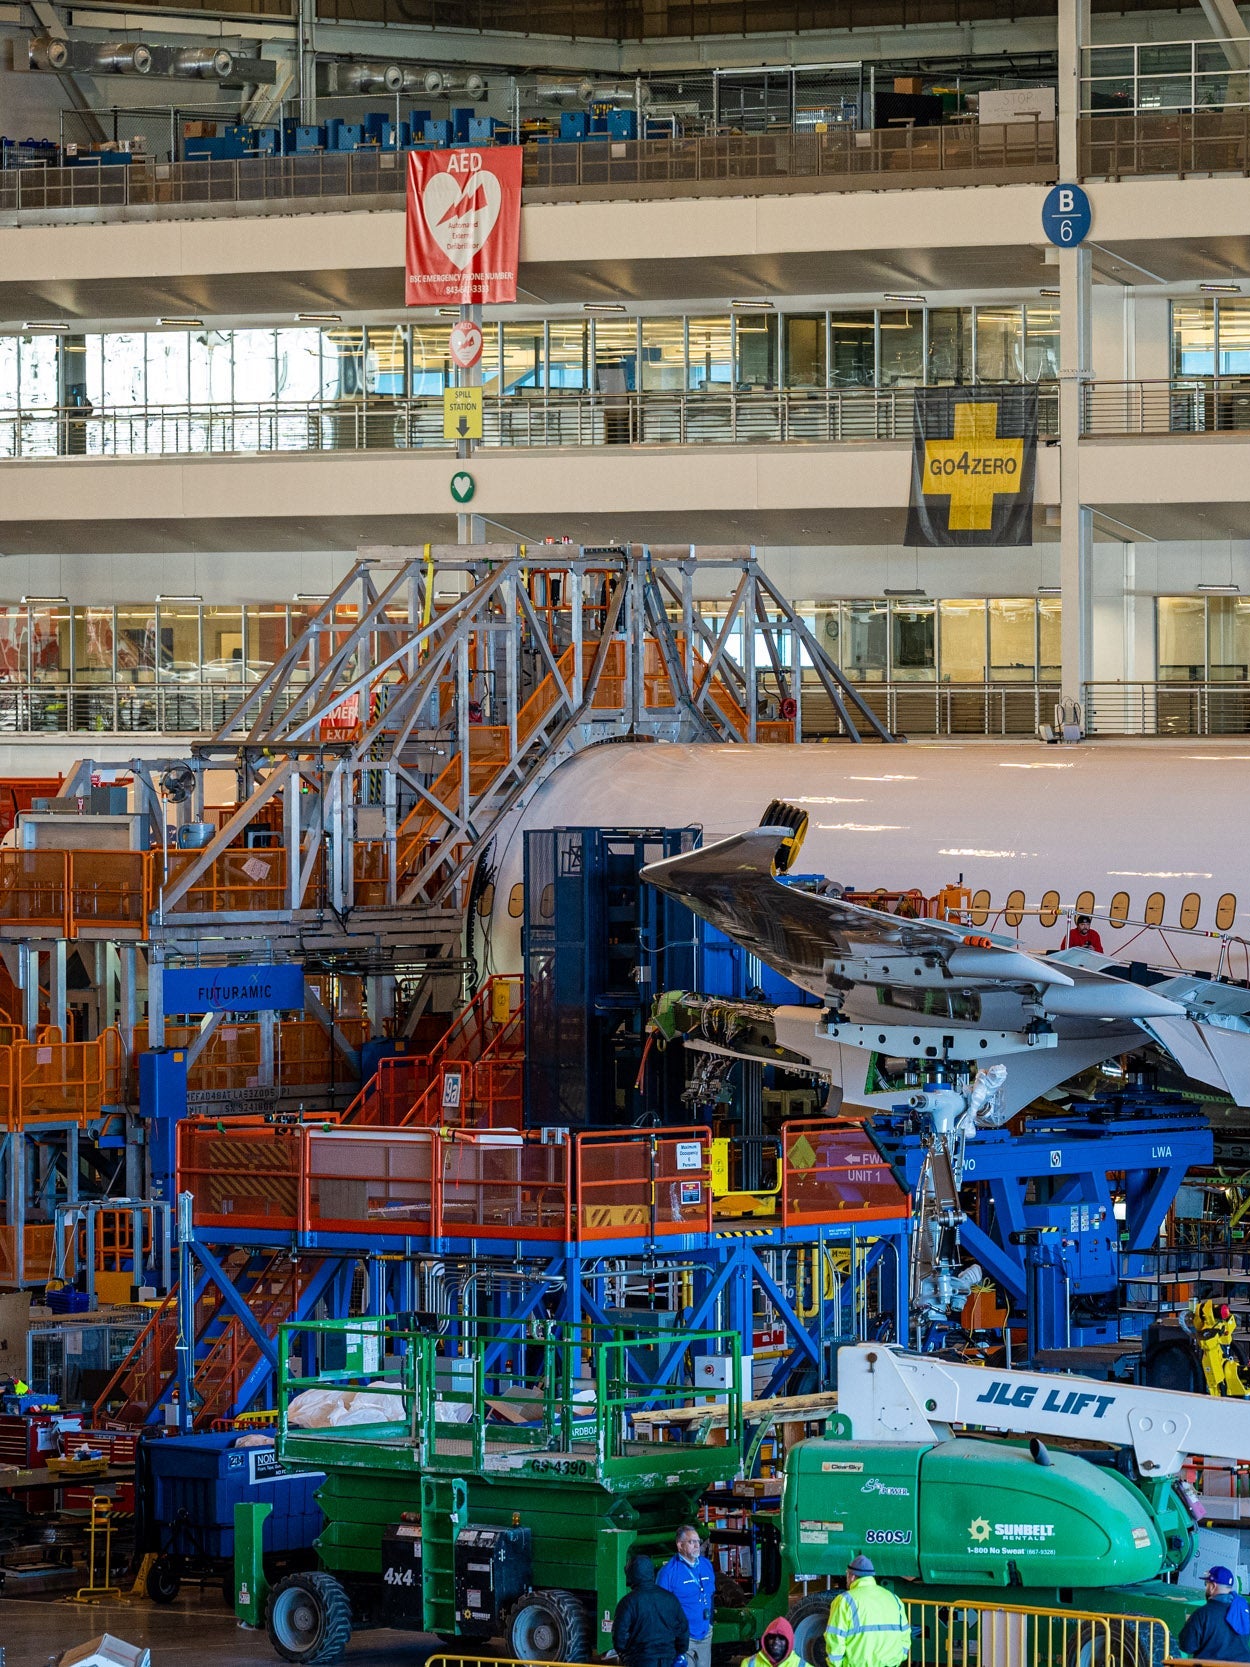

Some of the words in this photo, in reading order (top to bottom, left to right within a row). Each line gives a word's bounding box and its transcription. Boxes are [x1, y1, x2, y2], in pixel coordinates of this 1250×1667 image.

[447, 152, 482, 172] AED
[1060, 190, 1074, 212] B
[1061, 220, 1072, 241] 6
[423, 273, 461, 282] EMERGENCY
[930, 451, 1017, 475] GO4ZERO
[198, 984, 272, 1001] FUTURAMIC
[445, 1078, 459, 1103] 9a
[863, 1153, 883, 1165] FW
[1152, 1146, 1172, 1158] LWA
[848, 1171, 872, 1182] UNIT
[875, 1171, 880, 1182] 1
[976, 1382, 1039, 1408] JLG
[1042, 1389, 1116, 1418] LIFT
[532, 1459, 586, 1475] GS-4390
[866, 1530, 912, 1543] 860SJ
[995, 1524, 1055, 1536] SUNBELT
[384, 1567, 412, 1586] 4x4
